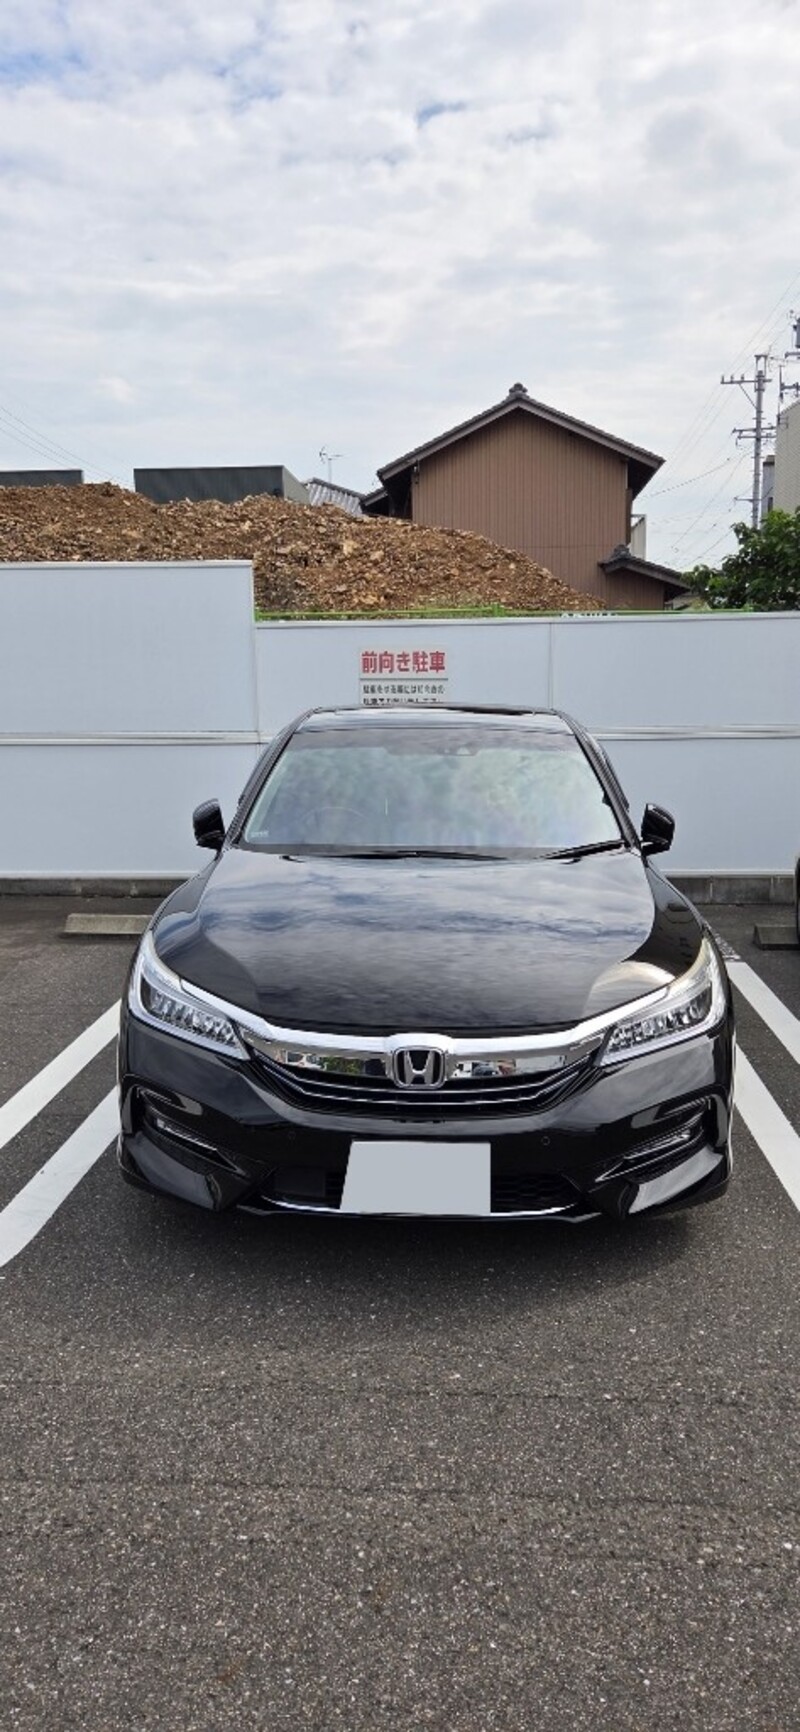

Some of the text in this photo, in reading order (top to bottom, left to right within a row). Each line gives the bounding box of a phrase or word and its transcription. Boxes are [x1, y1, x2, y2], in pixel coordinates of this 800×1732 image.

[361, 651, 446, 674] 前向き駐車
